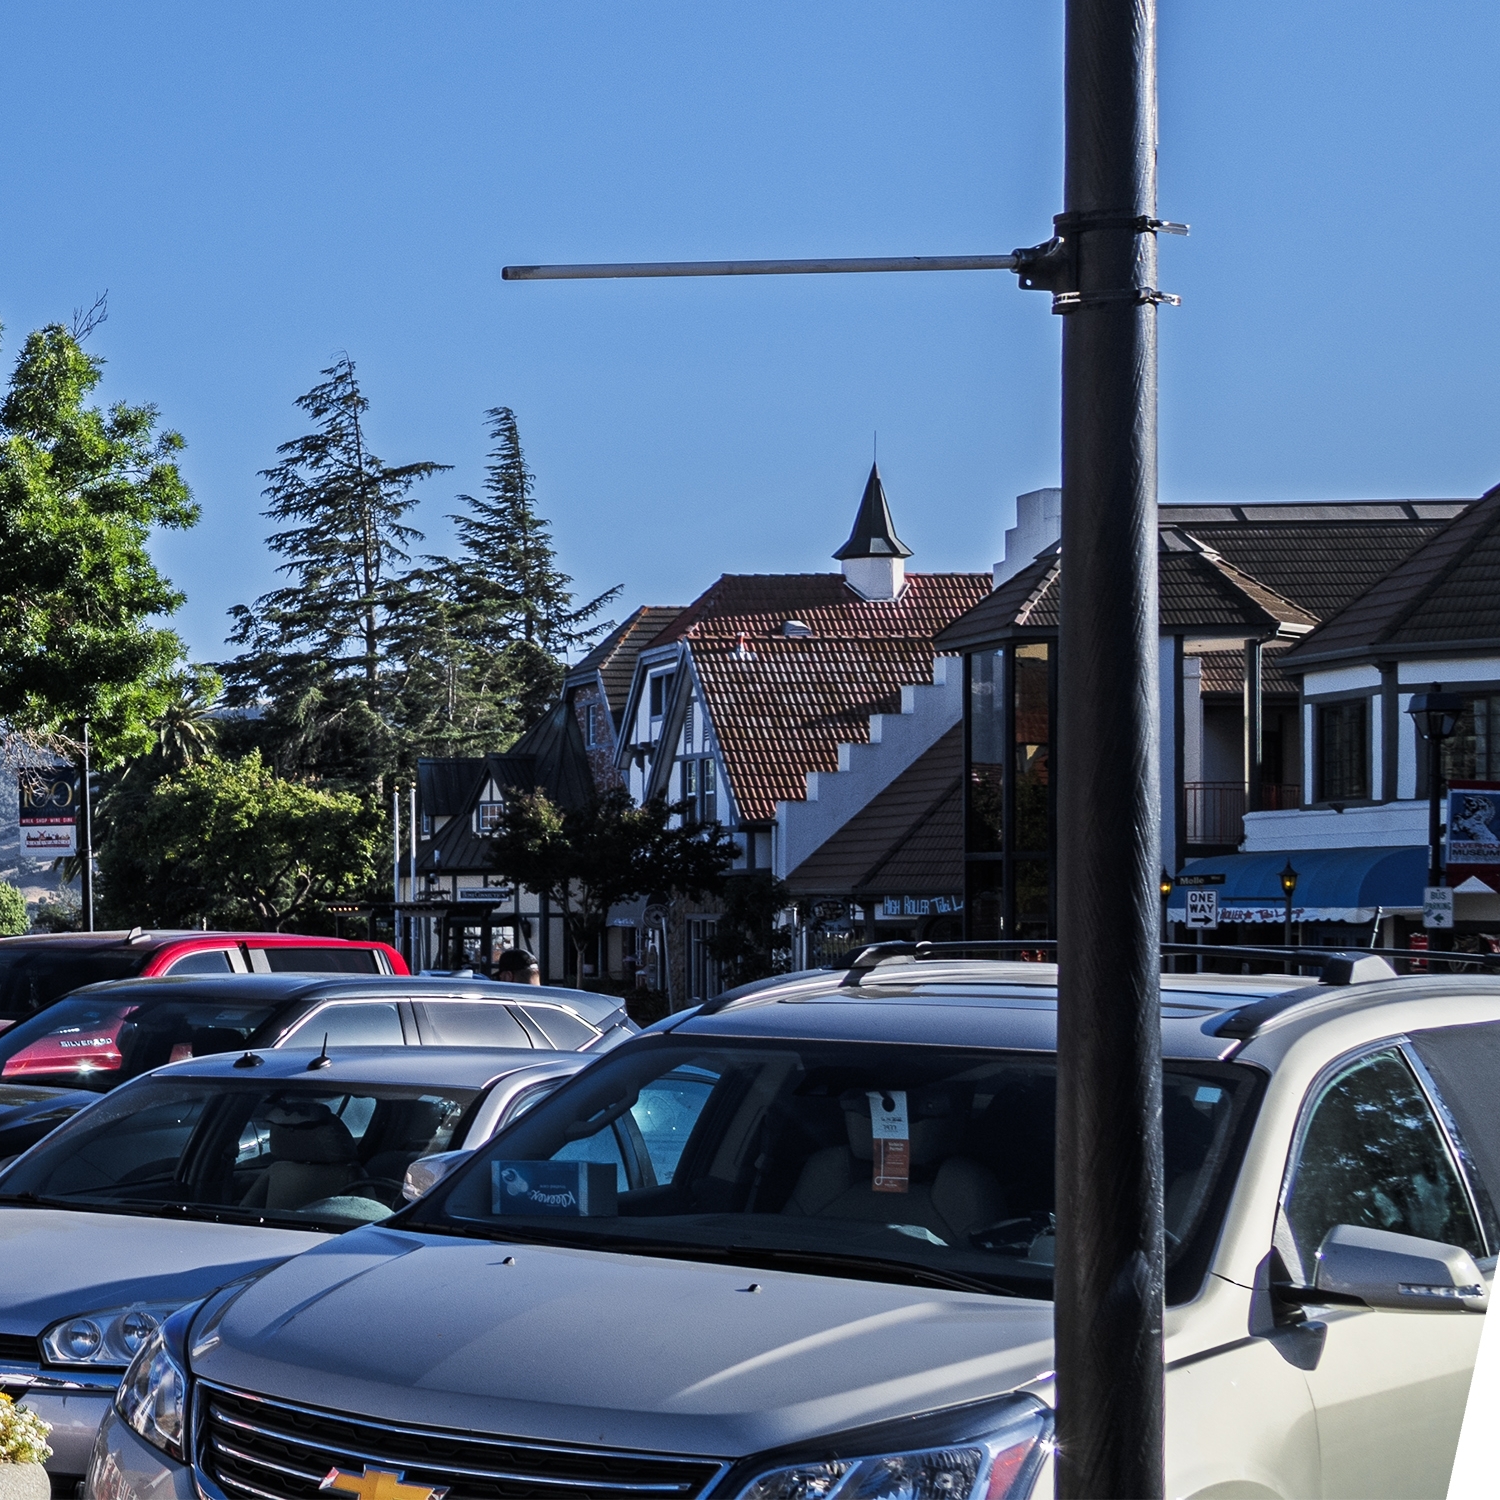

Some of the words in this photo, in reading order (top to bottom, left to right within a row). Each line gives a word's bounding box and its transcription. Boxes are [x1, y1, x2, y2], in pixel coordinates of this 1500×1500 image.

[1190, 893, 1214, 903] ONE
[1430, 891, 1446, 900] BUS
[883, 895, 900, 914] HIGH
[904, 895, 930, 914] ROLLER
[1189, 903, 1214, 913] WAY
[1425, 902, 1451, 911] PARKING
[530, 1189, 576, 1208] Kleenex
